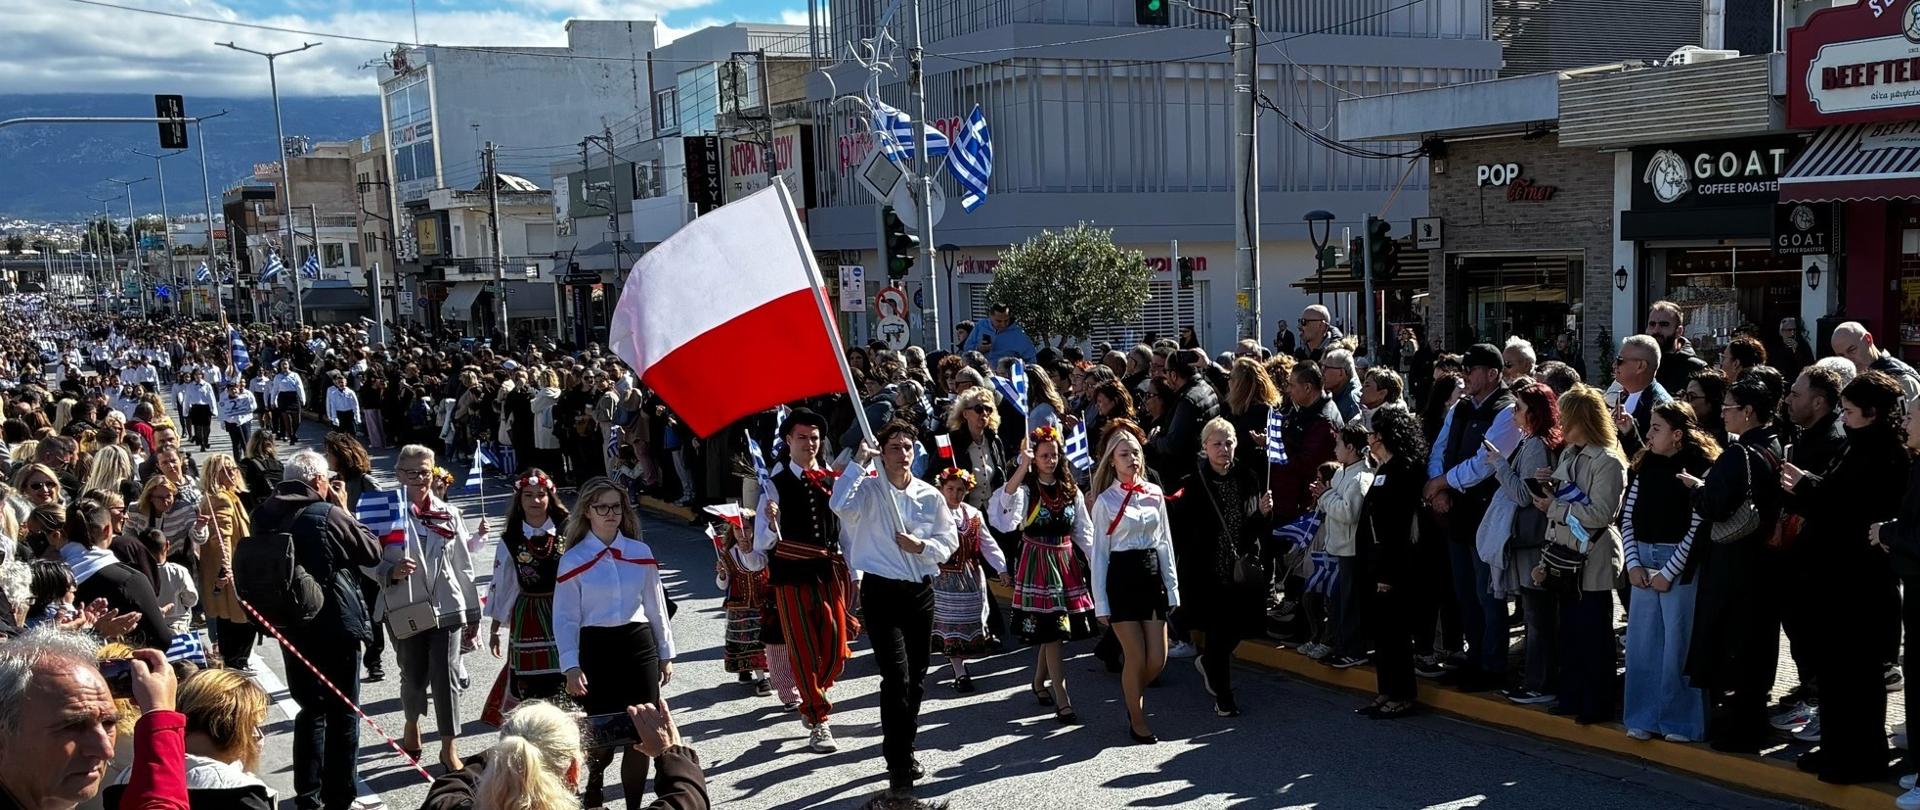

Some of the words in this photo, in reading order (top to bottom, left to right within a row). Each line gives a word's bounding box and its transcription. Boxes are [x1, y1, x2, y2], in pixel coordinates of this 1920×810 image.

[730, 143, 757, 177] ΑΓΟΡΑ
[759, 135, 793, 172] ΧΣΟΥ
[1694, 149, 1787, 179] GOAT
[1478, 163, 1519, 186] POP
[1698, 183, 1736, 195] COFFEE
[1779, 233, 1824, 246] GOAT
